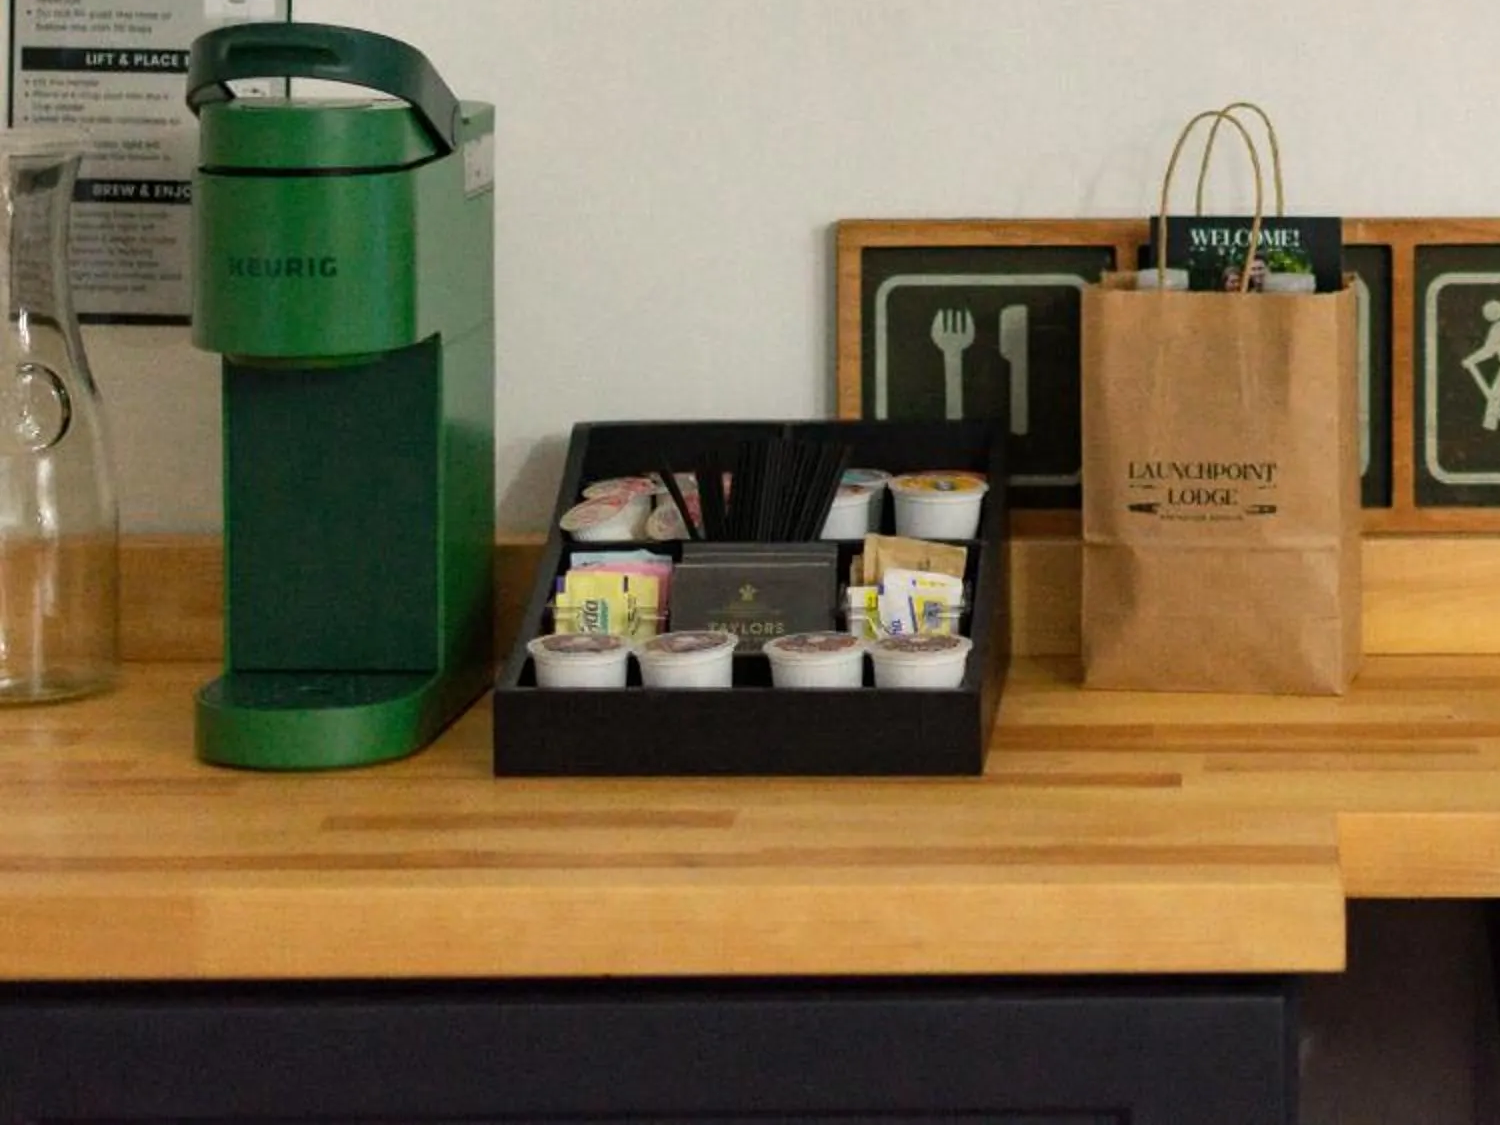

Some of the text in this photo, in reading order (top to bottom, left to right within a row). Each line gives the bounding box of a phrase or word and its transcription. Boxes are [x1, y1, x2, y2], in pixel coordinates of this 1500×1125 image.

[86, 53, 179, 67] LIFT & PLACE
[93, 184, 192, 198] BREW & ENJO
[1190, 228, 1300, 247] WELCOME!
[229, 256, 337, 278] KEURIG
[1127, 461, 1277, 482] LAUNCHPOINT
[1167, 488, 1238, 506] LODGE
[707, 621, 785, 635] TAYLORS
